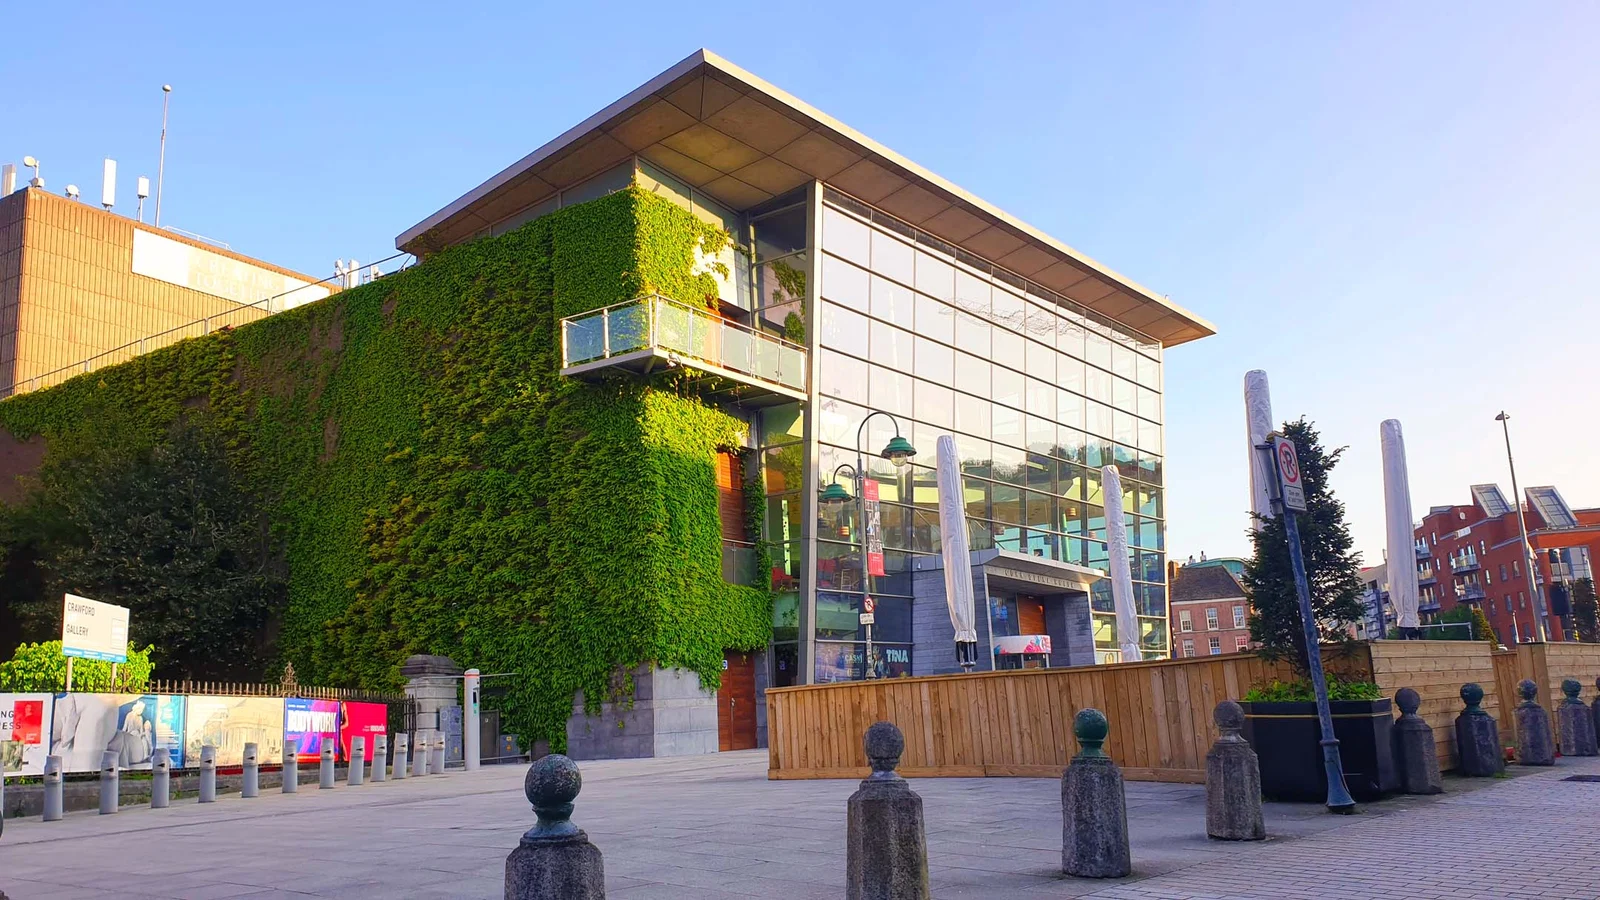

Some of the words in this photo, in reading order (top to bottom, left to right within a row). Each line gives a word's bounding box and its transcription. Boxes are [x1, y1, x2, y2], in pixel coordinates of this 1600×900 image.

[67, 602, 96, 616] CRAWFORD
[66, 624, 89, 636] GALLERY
[886, 649, 909, 663] TINA
[0, 721, 21, 730] ESS
[287, 710, 337, 733] BODYWORK
